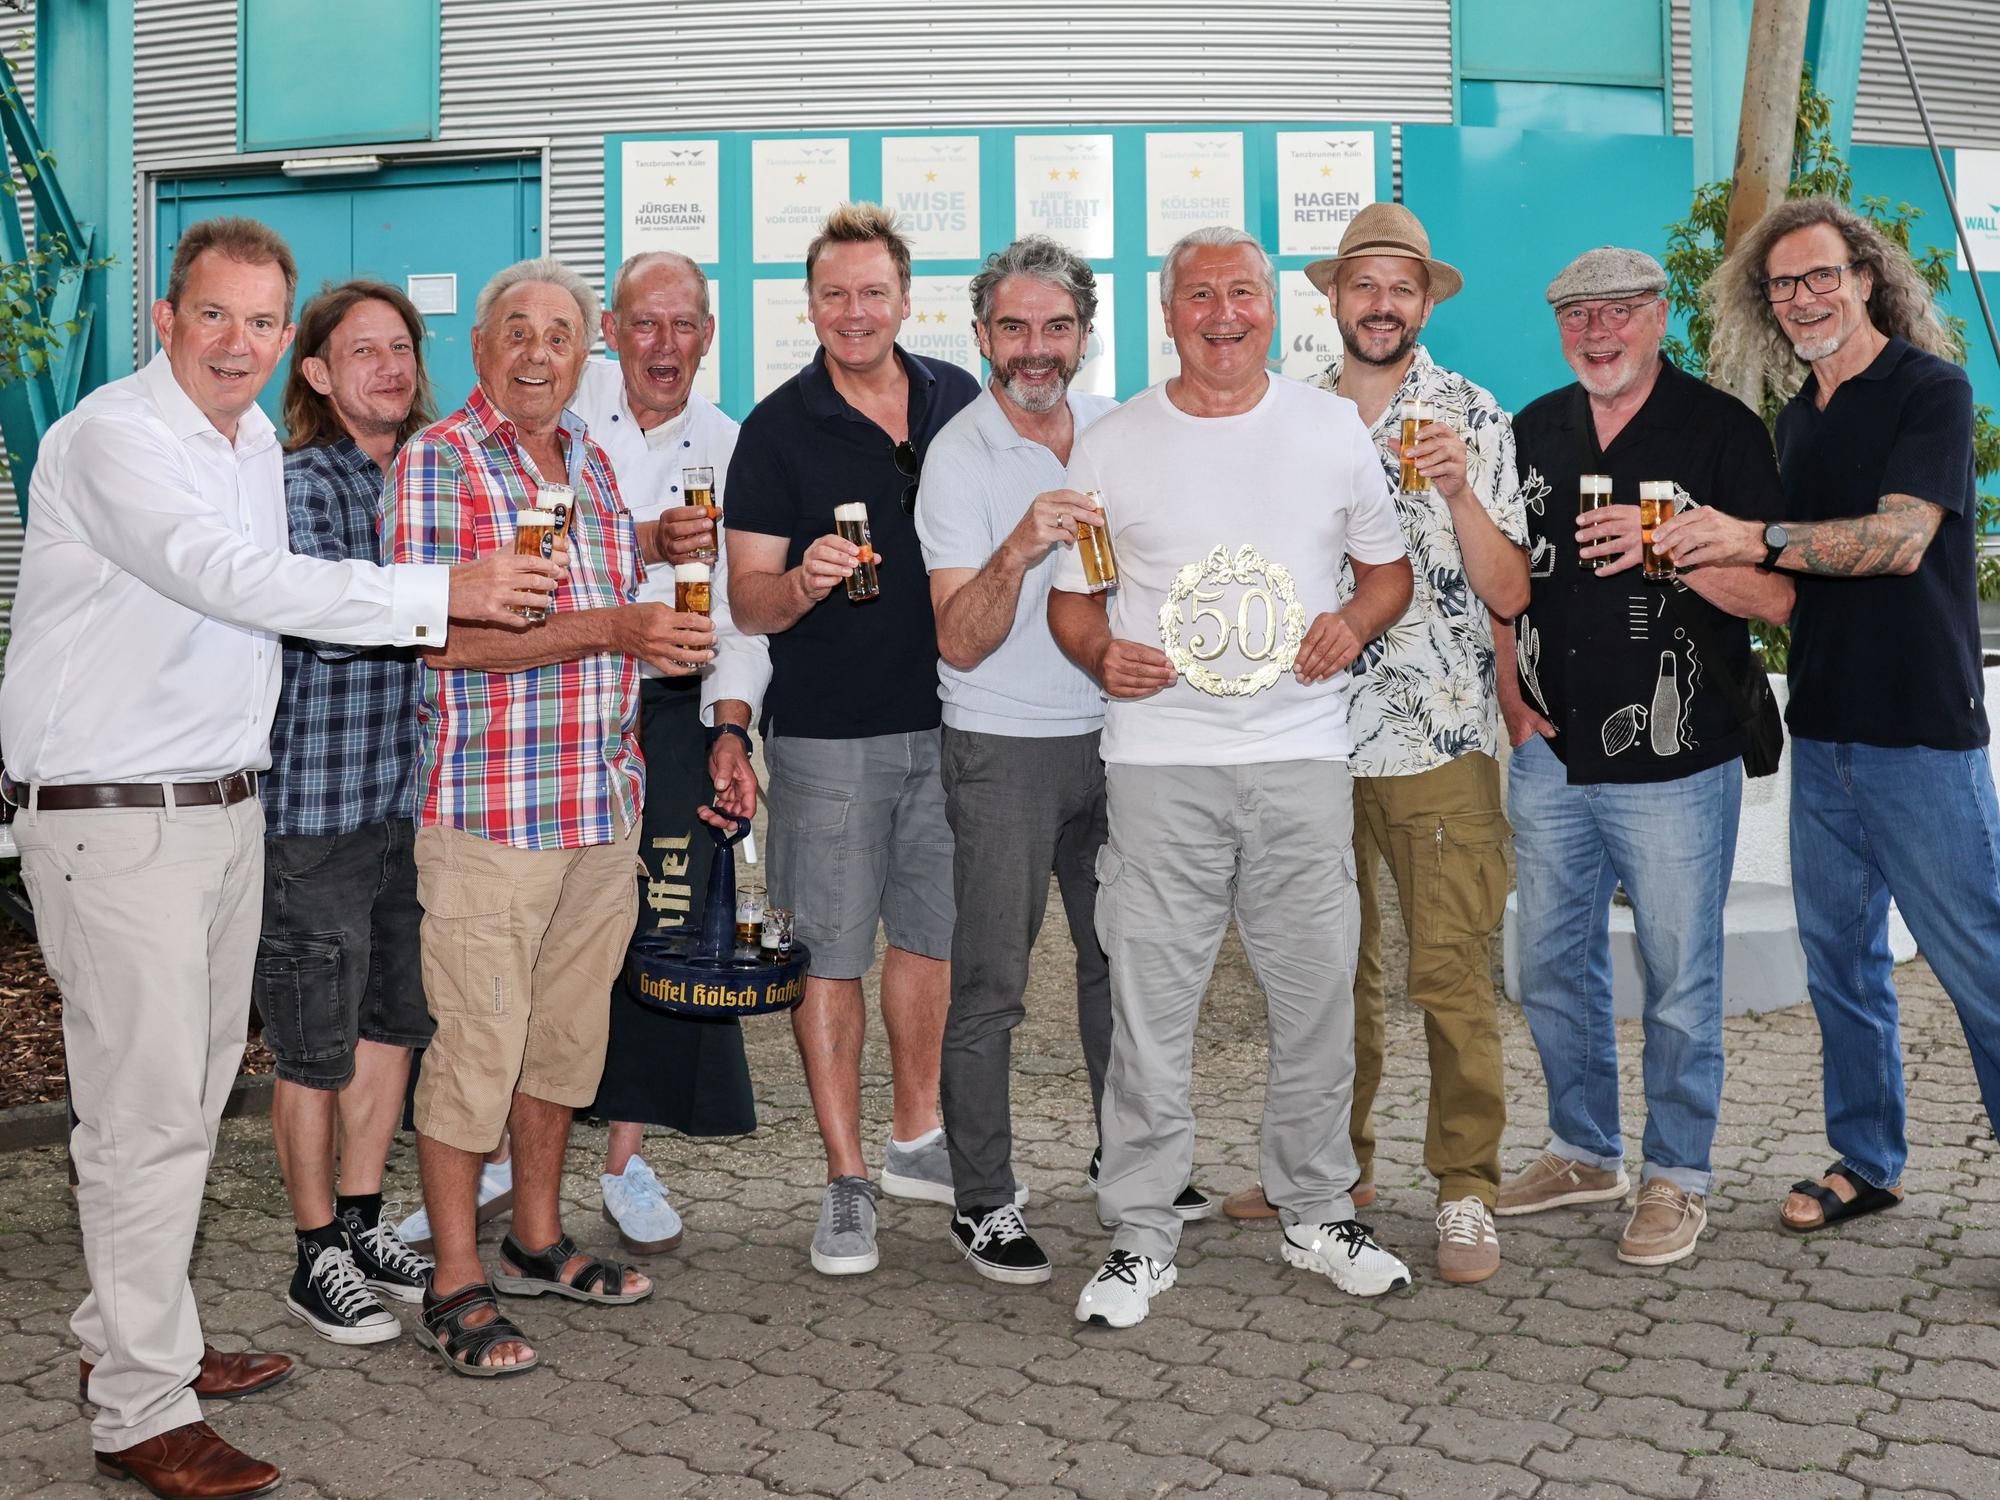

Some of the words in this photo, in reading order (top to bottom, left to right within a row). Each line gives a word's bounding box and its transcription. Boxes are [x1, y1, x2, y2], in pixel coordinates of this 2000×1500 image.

[1291, 150, 1342, 158] Tanzbrunnen
[1344, 149, 1362, 158] Köln
[636, 160, 685, 168] Tanzbrunnen
[687, 159, 706, 168] Köln
[897, 191, 966, 211] WISE
[1161, 195, 1231, 209] KÖLSCHE
[1294, 192, 1359, 206] HAGEN
[639, 201, 687, 213] JÜRGEN
[691, 203, 702, 213] B.
[781, 204, 821, 214] JÜRGEN
[1029, 199, 1100, 217] TALENT
[1161, 209, 1231, 219] WEIHNACHT
[635, 215, 705, 225] HAUSMANN
[765, 215, 787, 224] VON
[898, 212, 967, 232] GUYS
[1046, 217, 1089, 229] PROBE
[1964, 216, 1998, 231] WALL
[898, 334, 968, 349] UDWIG
[1189, 588, 1277, 661] 50
[640, 972, 687, 1003] Gaffel
[692, 984, 758, 1008] Kölsch
